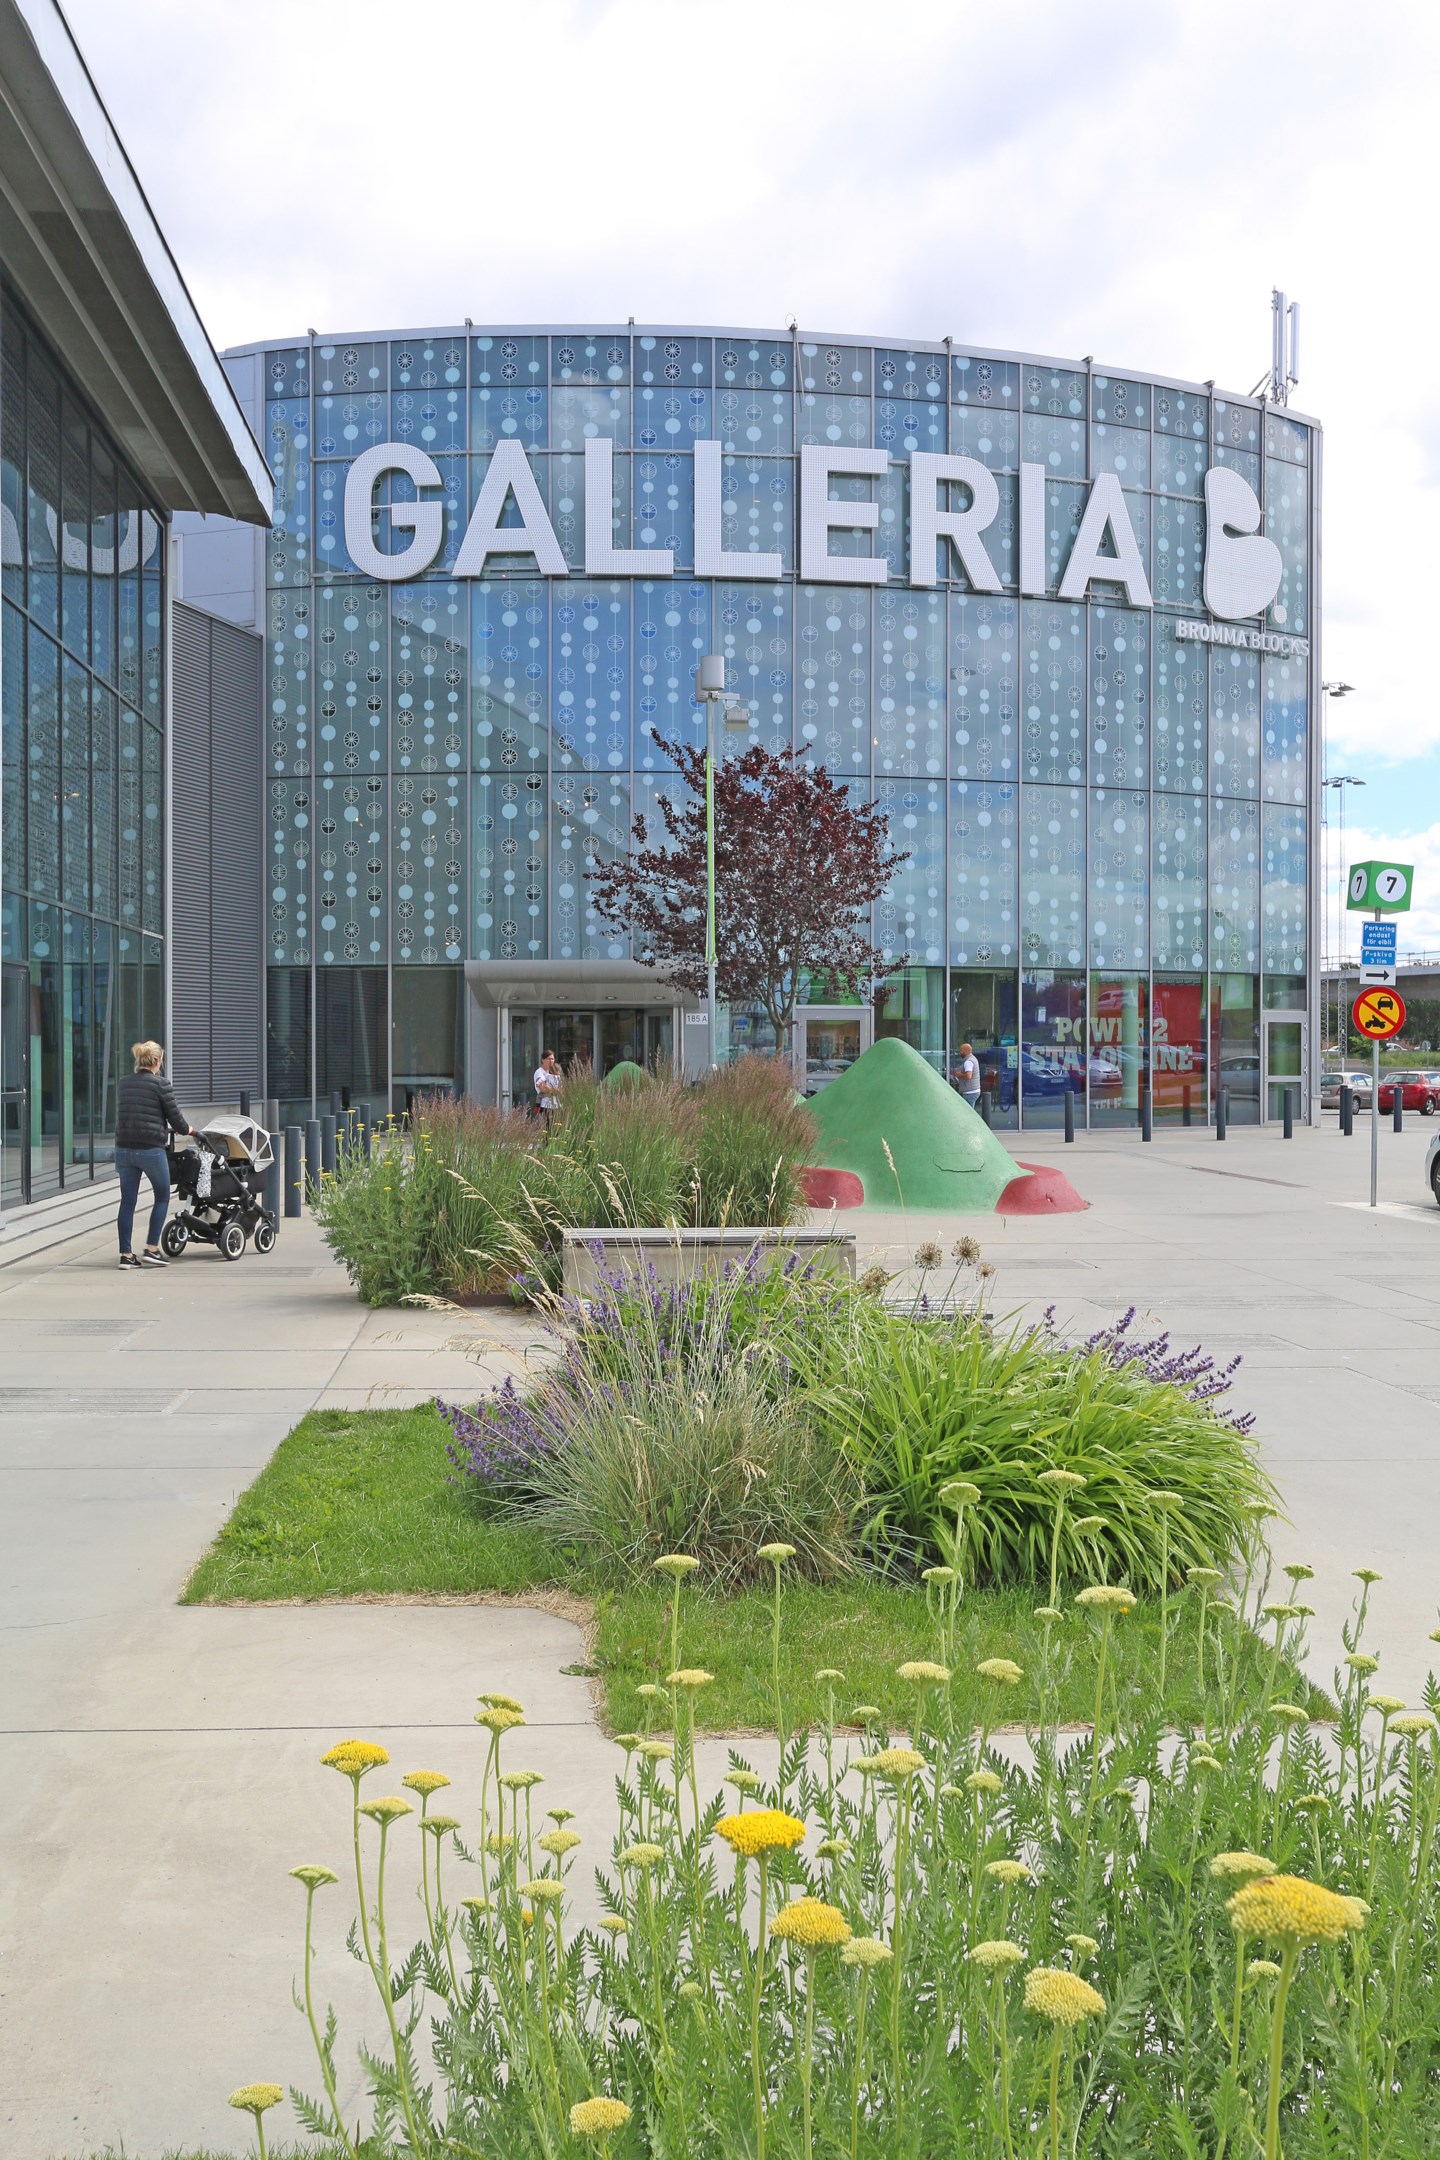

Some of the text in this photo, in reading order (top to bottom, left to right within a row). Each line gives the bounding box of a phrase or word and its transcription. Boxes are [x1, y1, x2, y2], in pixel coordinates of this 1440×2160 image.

[344, 437, 1153, 607] GALLERIA
[1175, 619, 1310, 657] BROMMA BLOCKS
[1356, 876, 1362, 893] 7
[1387, 876, 1397, 893] 7
[1365, 925, 1395, 933] Parkering
[1365, 950, 1393, 958] P-skiva
[1152, 1017, 1168, 1042] 2
[1099, 1045, 1193, 1071] OINE
